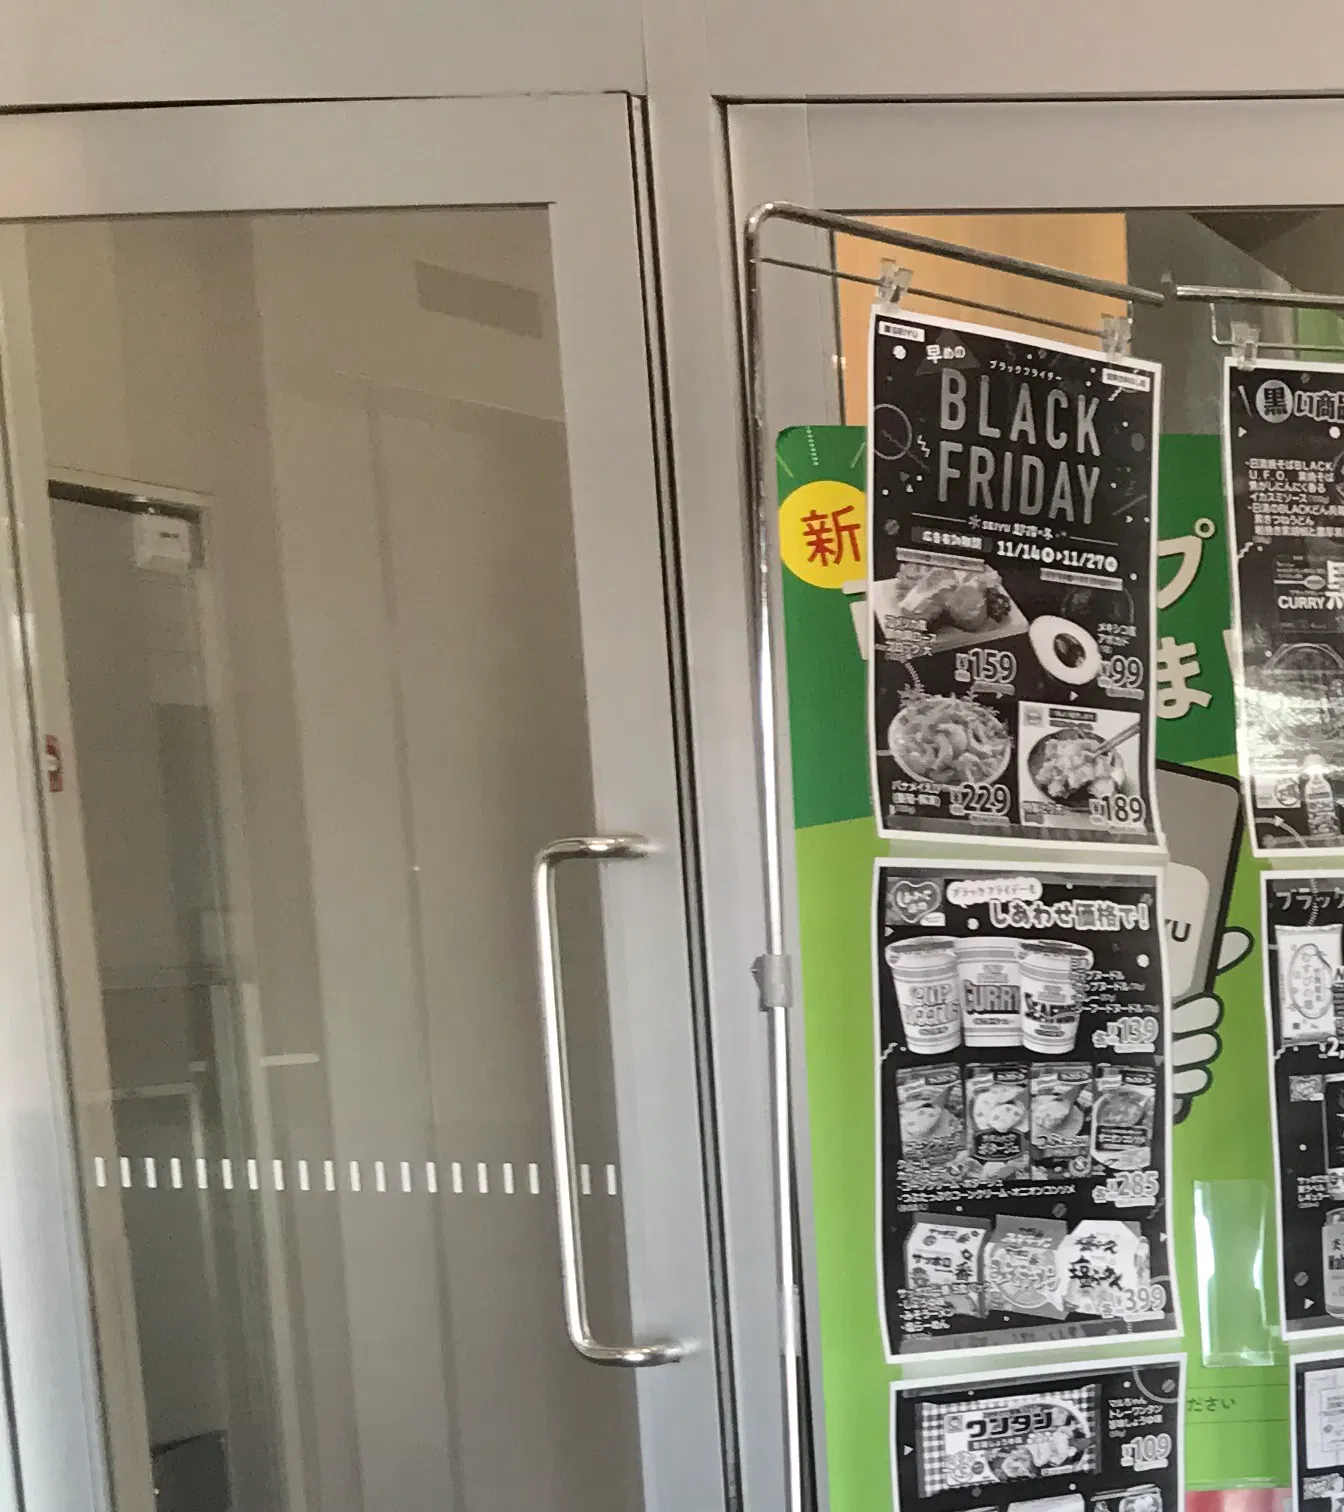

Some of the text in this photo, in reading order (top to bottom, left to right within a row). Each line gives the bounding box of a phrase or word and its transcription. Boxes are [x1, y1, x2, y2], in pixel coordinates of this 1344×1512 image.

[940, 368, 1100, 456] BLACK
[938, 440, 1100, 524] FRIDAY
[801, 506, 861, 566] 新
[1278, 595, 1326, 609] CURRY
